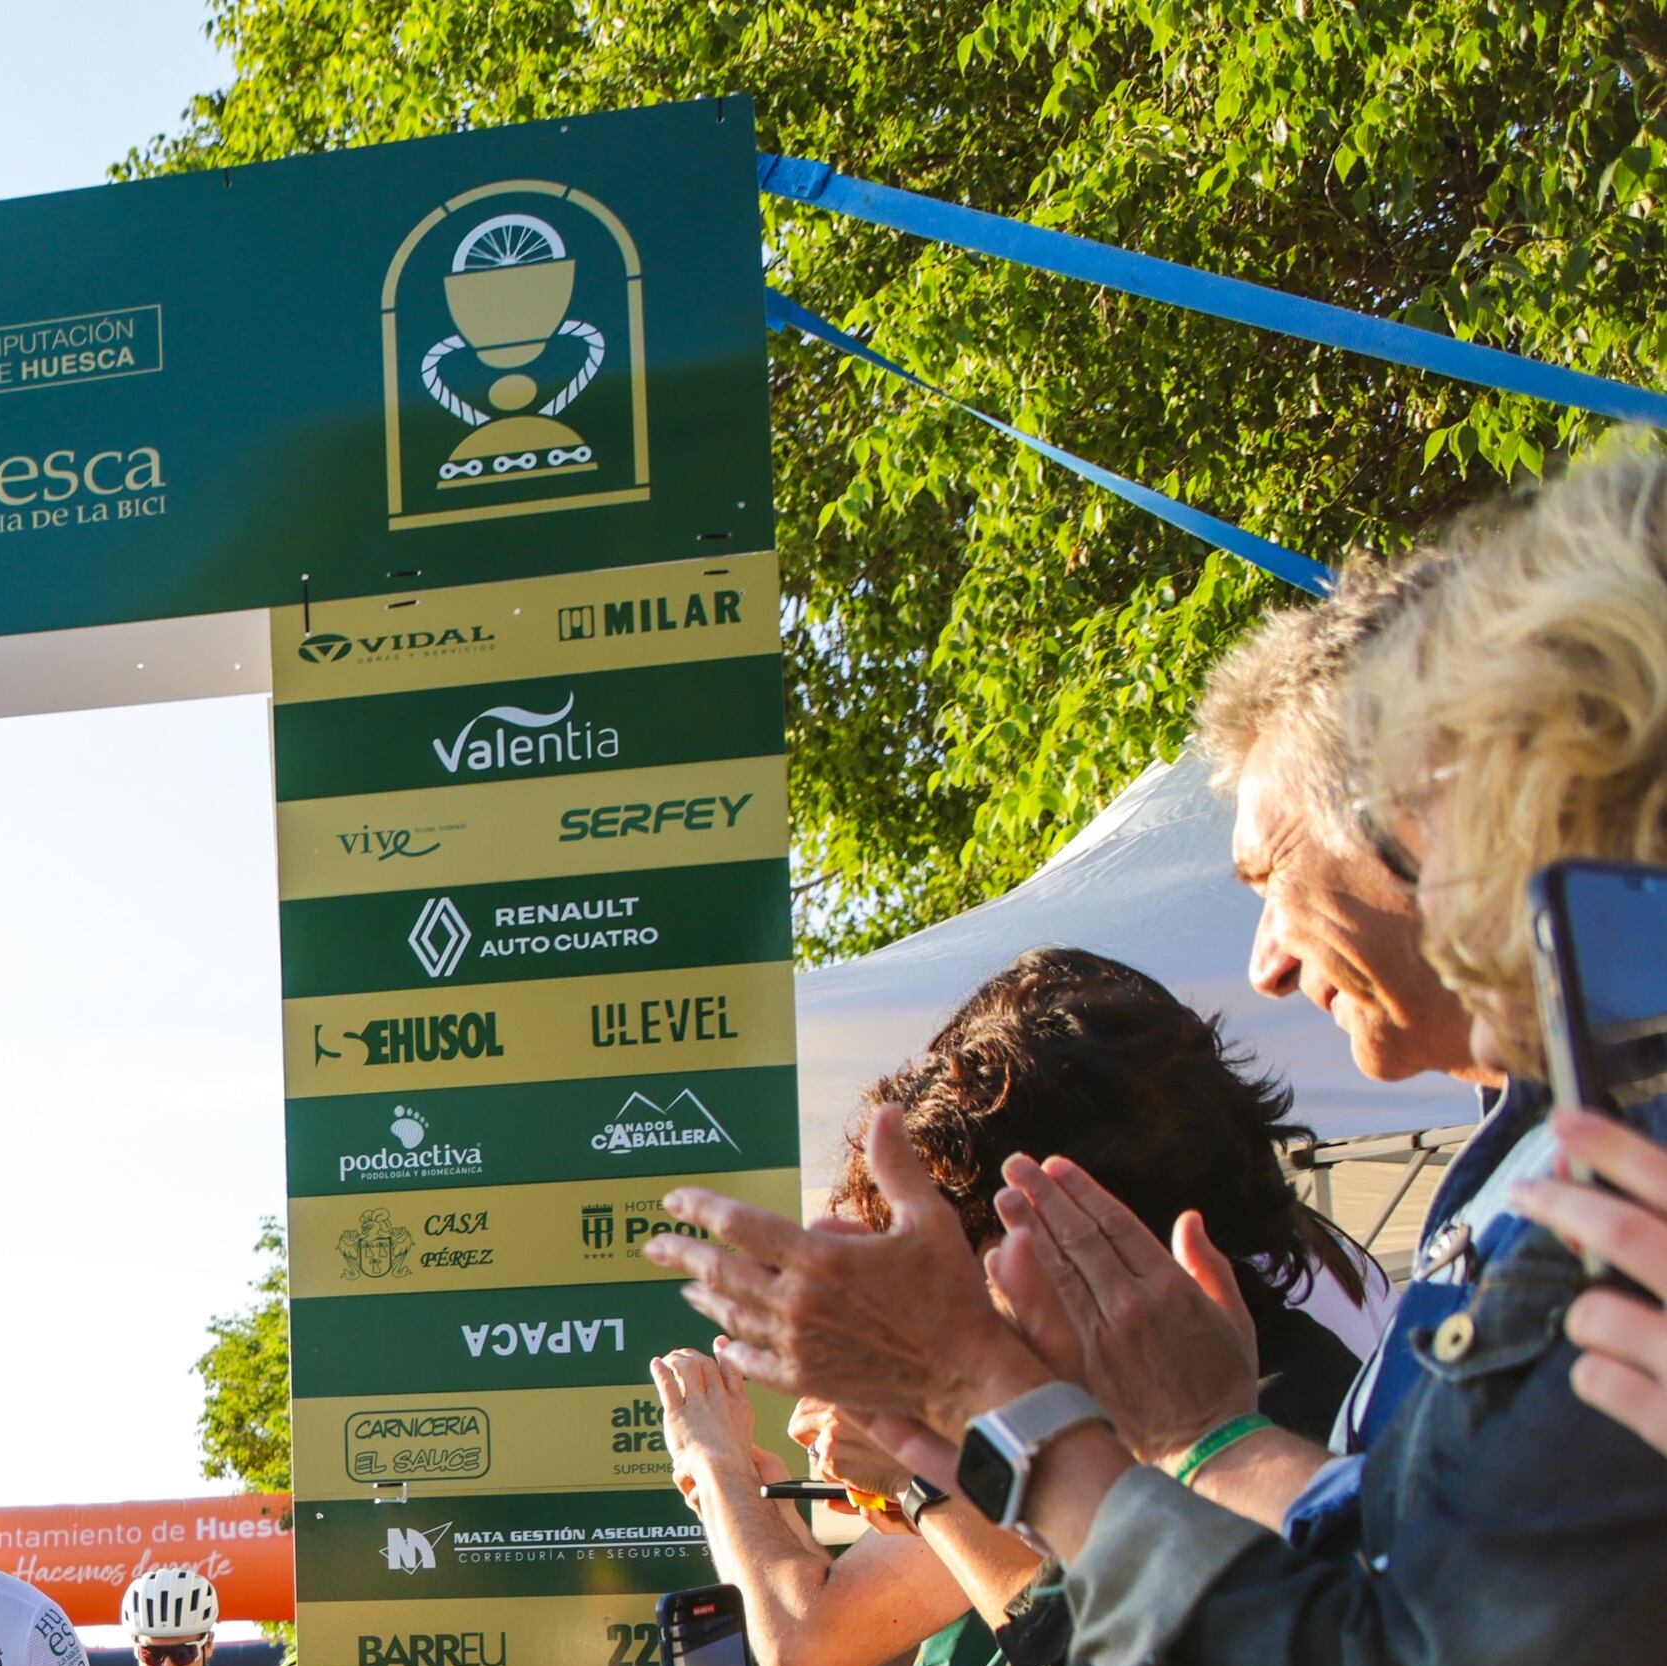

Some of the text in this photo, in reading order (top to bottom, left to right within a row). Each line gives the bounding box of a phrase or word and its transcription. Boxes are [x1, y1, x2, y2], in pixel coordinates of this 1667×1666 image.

[21, 346, 135, 381] HUESCA
[117, 495, 167, 519] BICI
[604, 590, 742, 636] MILAR
[357, 626, 495, 653] VIDAL
[357, 653, 400, 664] OBRAS
[424, 644, 496, 657] SERVICIOS
[433, 703, 619, 773] Valentia
[558, 793, 755, 843] SERFEY
[336, 825, 441, 862] vive
[494, 897, 640, 928] RENAULT
[480, 927, 659, 958] AUTO CUATRO
[591, 1127, 722, 1155] CABALLERA
[339, 1143, 483, 1181] podoactiva
[360, 1169, 411, 1181] PODOLOGÍA
[413, 1168, 420, 1177] Y
[625, 1200, 665, 1213] HOTE
[423, 1209, 490, 1237] CASA
[420, 1246, 494, 1270] PÉREZ
[627, 1249, 642, 1258] DE
[355, 1415, 480, 1440] CARNICERÍA
[612, 1430, 666, 1453] ara
[355, 1447, 482, 1475] EL SAUCE
[613, 1463, 675, 1475] SUPERME
[152, 1520, 186, 1542] de
[196, 1517, 290, 1541] Huesc
[454, 1531, 503, 1545] MATA
[510, 1527, 586, 1543] GESTIÓN
[12, 1553, 126, 1586] Hacemos
[458, 1549, 565, 1564] CORREDURÍA
[577, 1550, 595, 1560] DE
